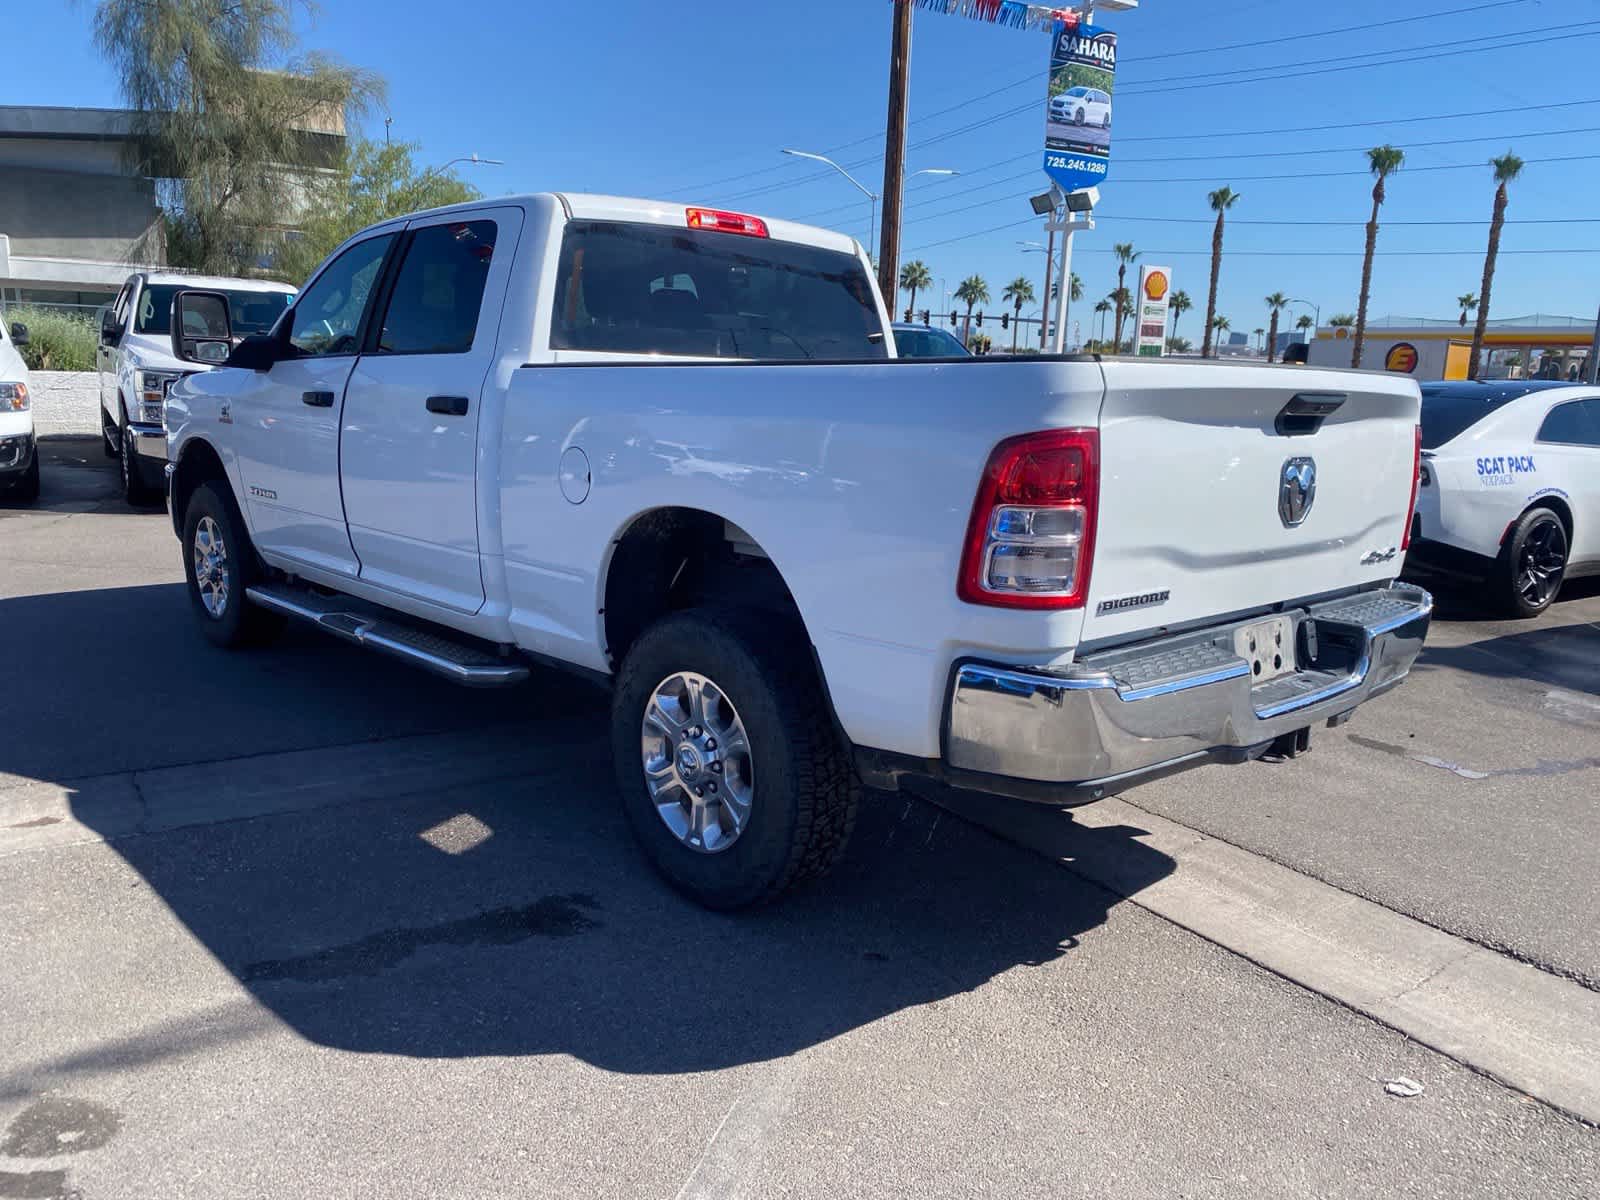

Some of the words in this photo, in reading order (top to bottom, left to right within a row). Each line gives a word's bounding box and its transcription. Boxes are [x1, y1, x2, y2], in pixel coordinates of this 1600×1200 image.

[1060, 34, 1115, 63] SAHARA
[1477, 457, 1505, 475] SCAT
[1507, 456, 1536, 472] PACK
[1102, 590, 1171, 612] BIGHORN
